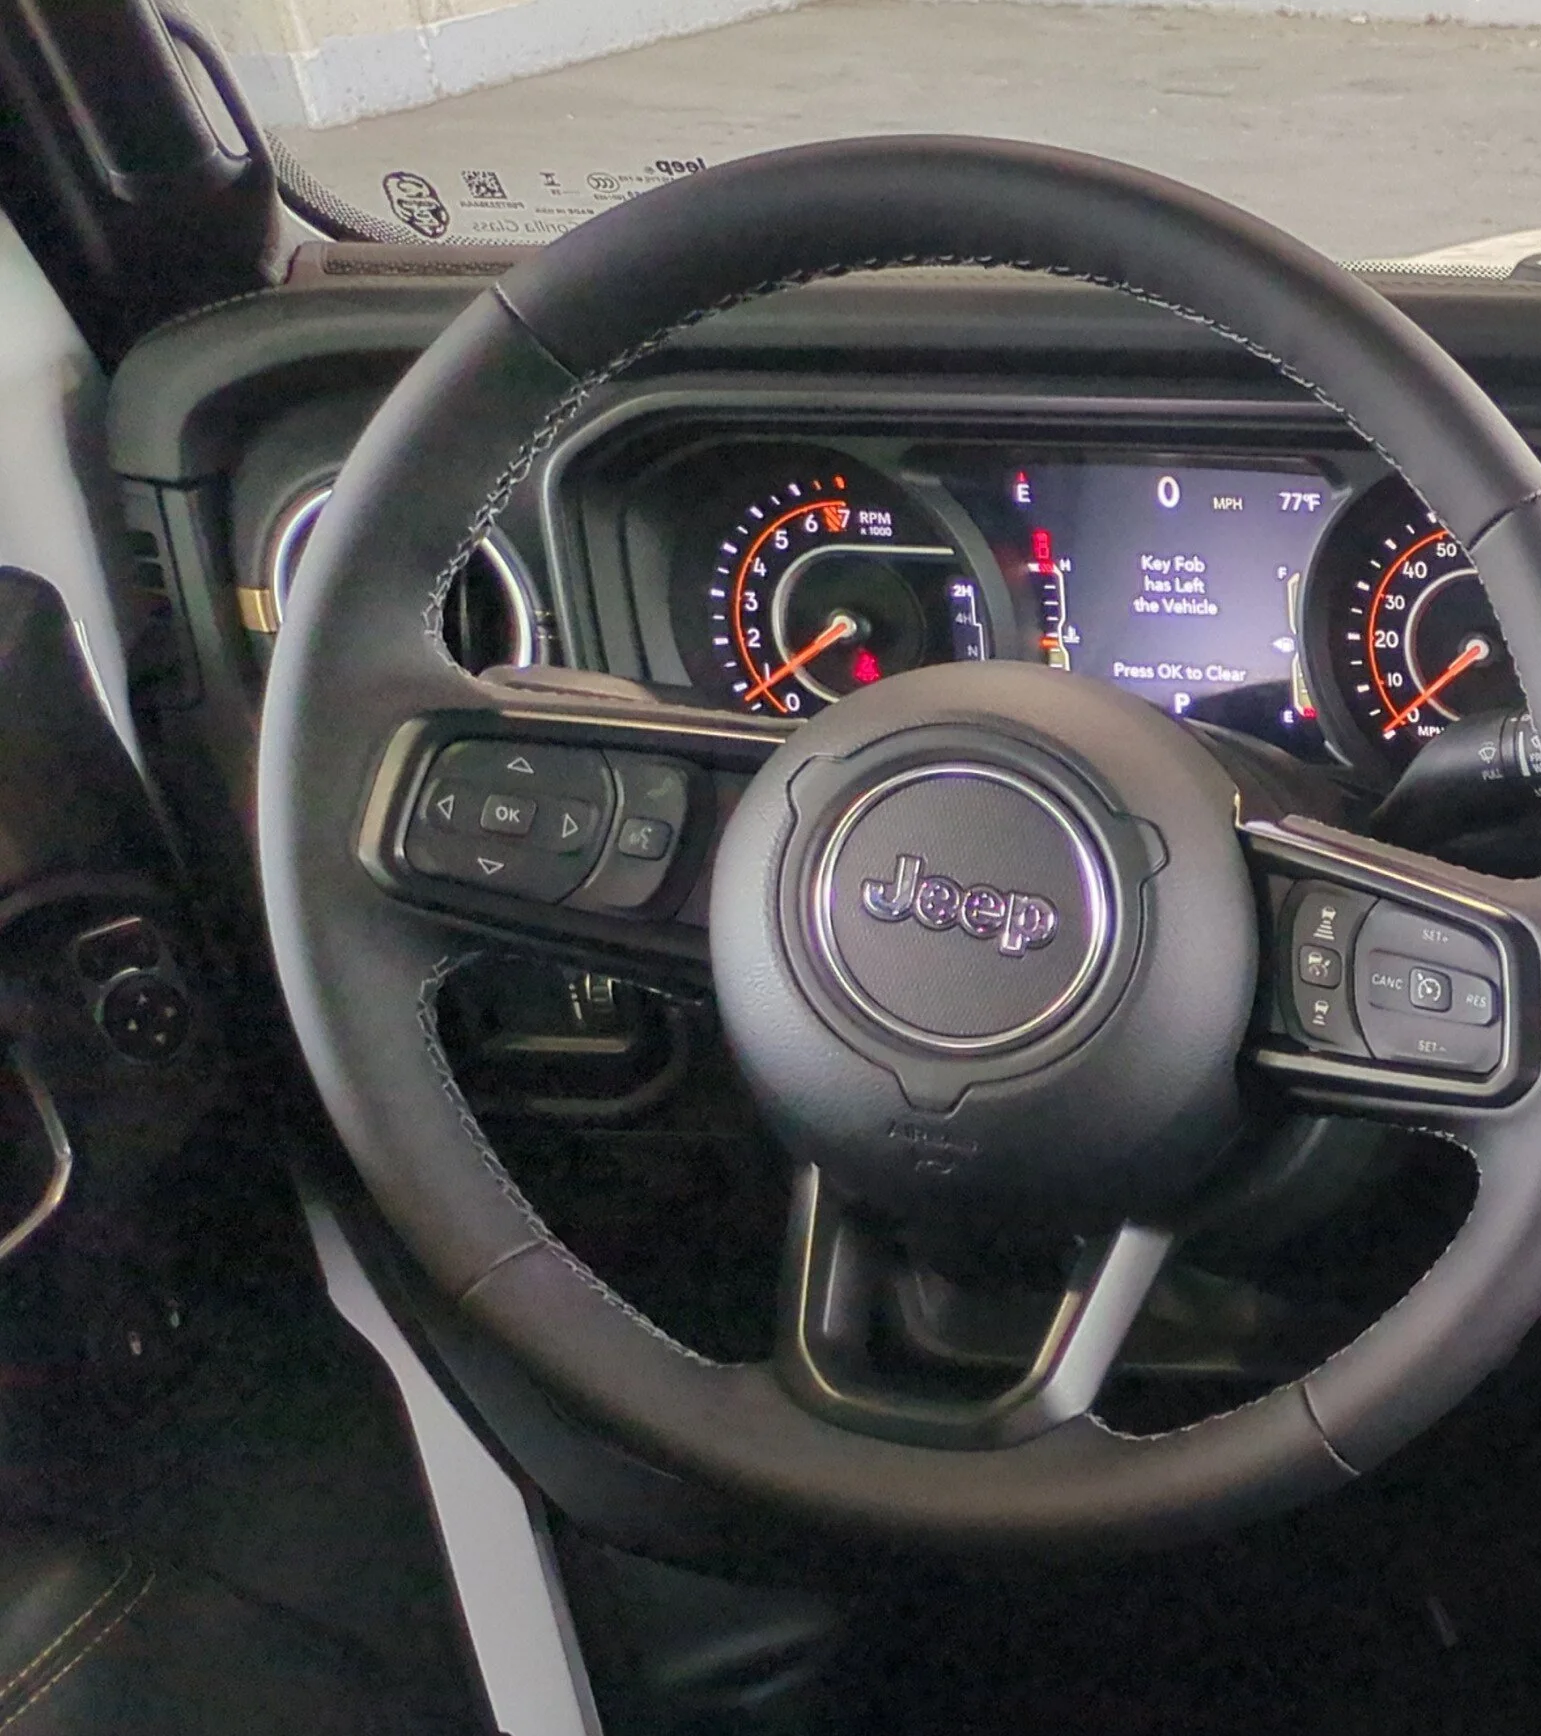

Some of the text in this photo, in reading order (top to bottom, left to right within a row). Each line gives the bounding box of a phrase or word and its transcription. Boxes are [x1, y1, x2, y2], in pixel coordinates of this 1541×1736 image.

[1014, 483, 1031, 503] E
[1156, 475, 1244, 512] 0 MPH
[804, 513, 819, 533] 6
[837, 508, 851, 529] 7
[858, 510, 892, 526] RPM
[774, 529, 790, 551] 5
[868, 526, 893, 537] 1000
[1435, 542, 1458, 558] 50
[752, 556, 768, 578] 4
[1059, 559, 1072, 573] H
[1140, 555, 1206, 575] Key Fob
[1276, 566, 1288, 581] F
[1402, 560, 1429, 580] 40
[952, 584, 973, 598] 2H
[1143, 575, 1207, 596] has Left
[743, 591, 760, 612] 3
[1133, 596, 1219, 617] the Vehicle
[1384, 594, 1406, 612] 30
[954, 611, 973, 625] 4H
[746, 627, 762, 649] 2
[1373, 630, 1400, 650] 20
[967, 644, 979, 657] N
[1112, 661, 1248, 684] Press OK to Clear
[1386, 672, 1404, 688] 10
[784, 691, 801, 713] 0
[1174, 692, 1191, 714] P
[1282, 709, 1294, 724] E
[1406, 706, 1421, 724] 0
[495, 805, 522, 824] OK
[861, 852, 1059, 959] Jeep
[1371, 972, 1405, 991] CANC
[1465, 992, 1488, 1009] RES
